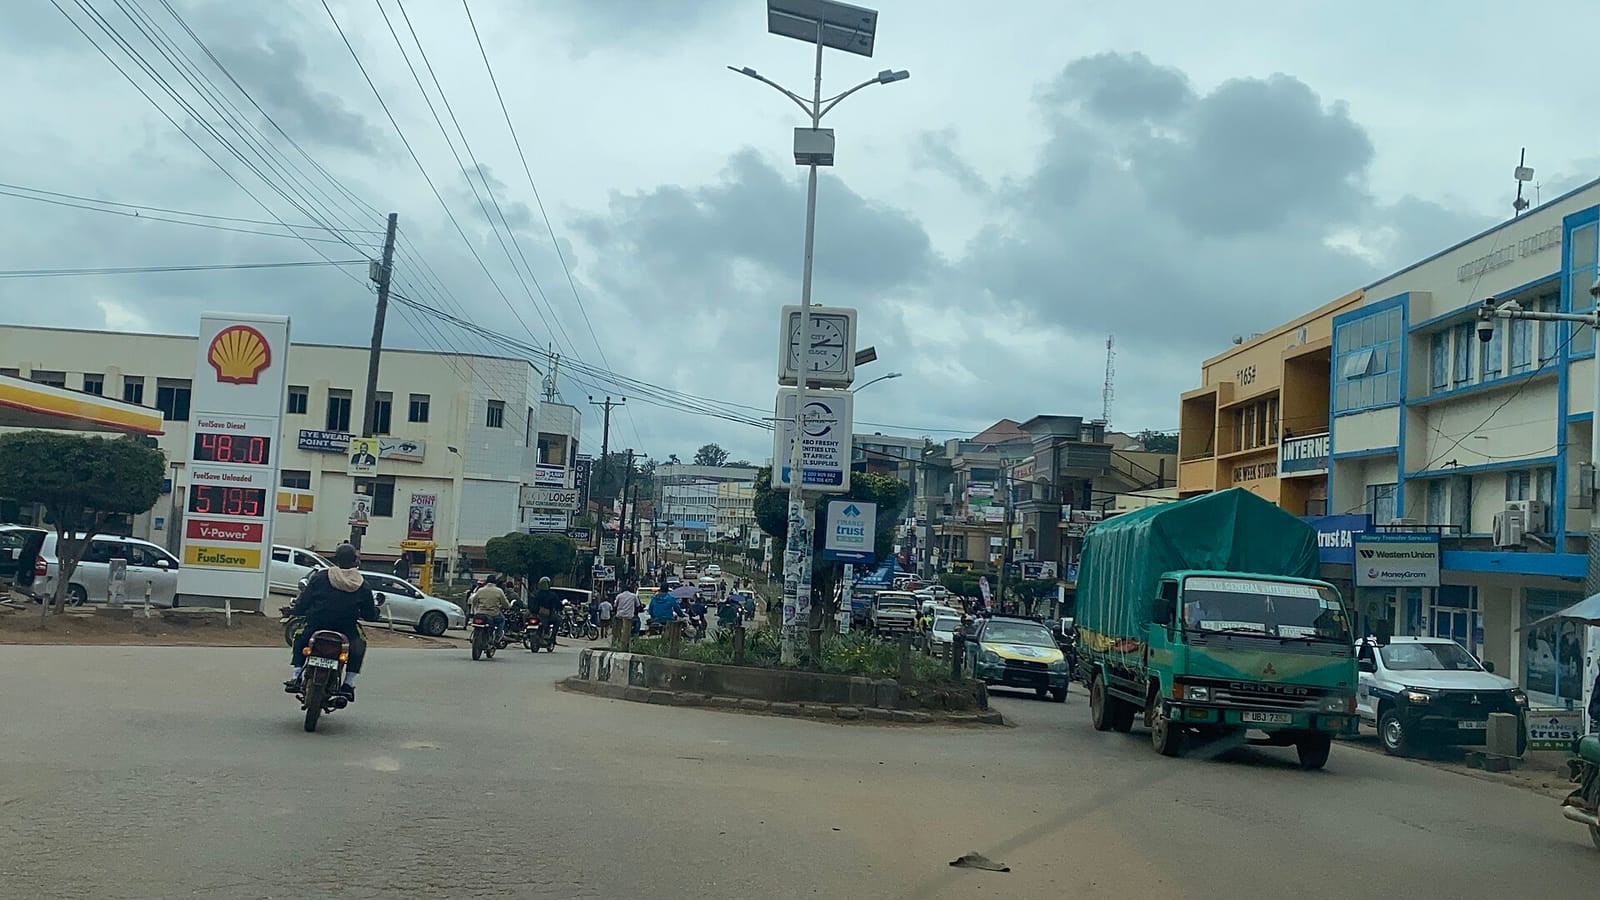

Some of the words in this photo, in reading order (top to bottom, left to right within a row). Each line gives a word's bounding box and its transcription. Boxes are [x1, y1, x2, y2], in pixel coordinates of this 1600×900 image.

[198, 420, 225, 428] FuelSave
[226, 422, 246, 430] Diesel
[300, 430, 319, 438] EYE
[321, 432, 350, 441] WEAR
[300, 438, 329, 446] POINT
[1284, 436, 1330, 460] INTERNE
[193, 472, 220, 480] FuelSave
[222, 473, 252, 482] Unleaded
[576, 466, 584, 486] ONE
[196, 486, 258, 516] 5195
[549, 493, 576, 503] LODGE
[200, 527, 247, 539] V-Power
[836, 526, 864, 536] trust
[1318, 529, 1340, 547] trust
[1340, 530, 1358, 548] BA
[197, 552, 246, 565] FuelSave
[1376, 551, 1410, 559] Western
[1411, 551, 1435, 559] Union
[1381, 571, 1426, 579] MoneyGram
[1224, 582, 1260, 593] GENERAL
[1230, 682, 1308, 695] CANTER
[1531, 729, 1580, 739] trust
